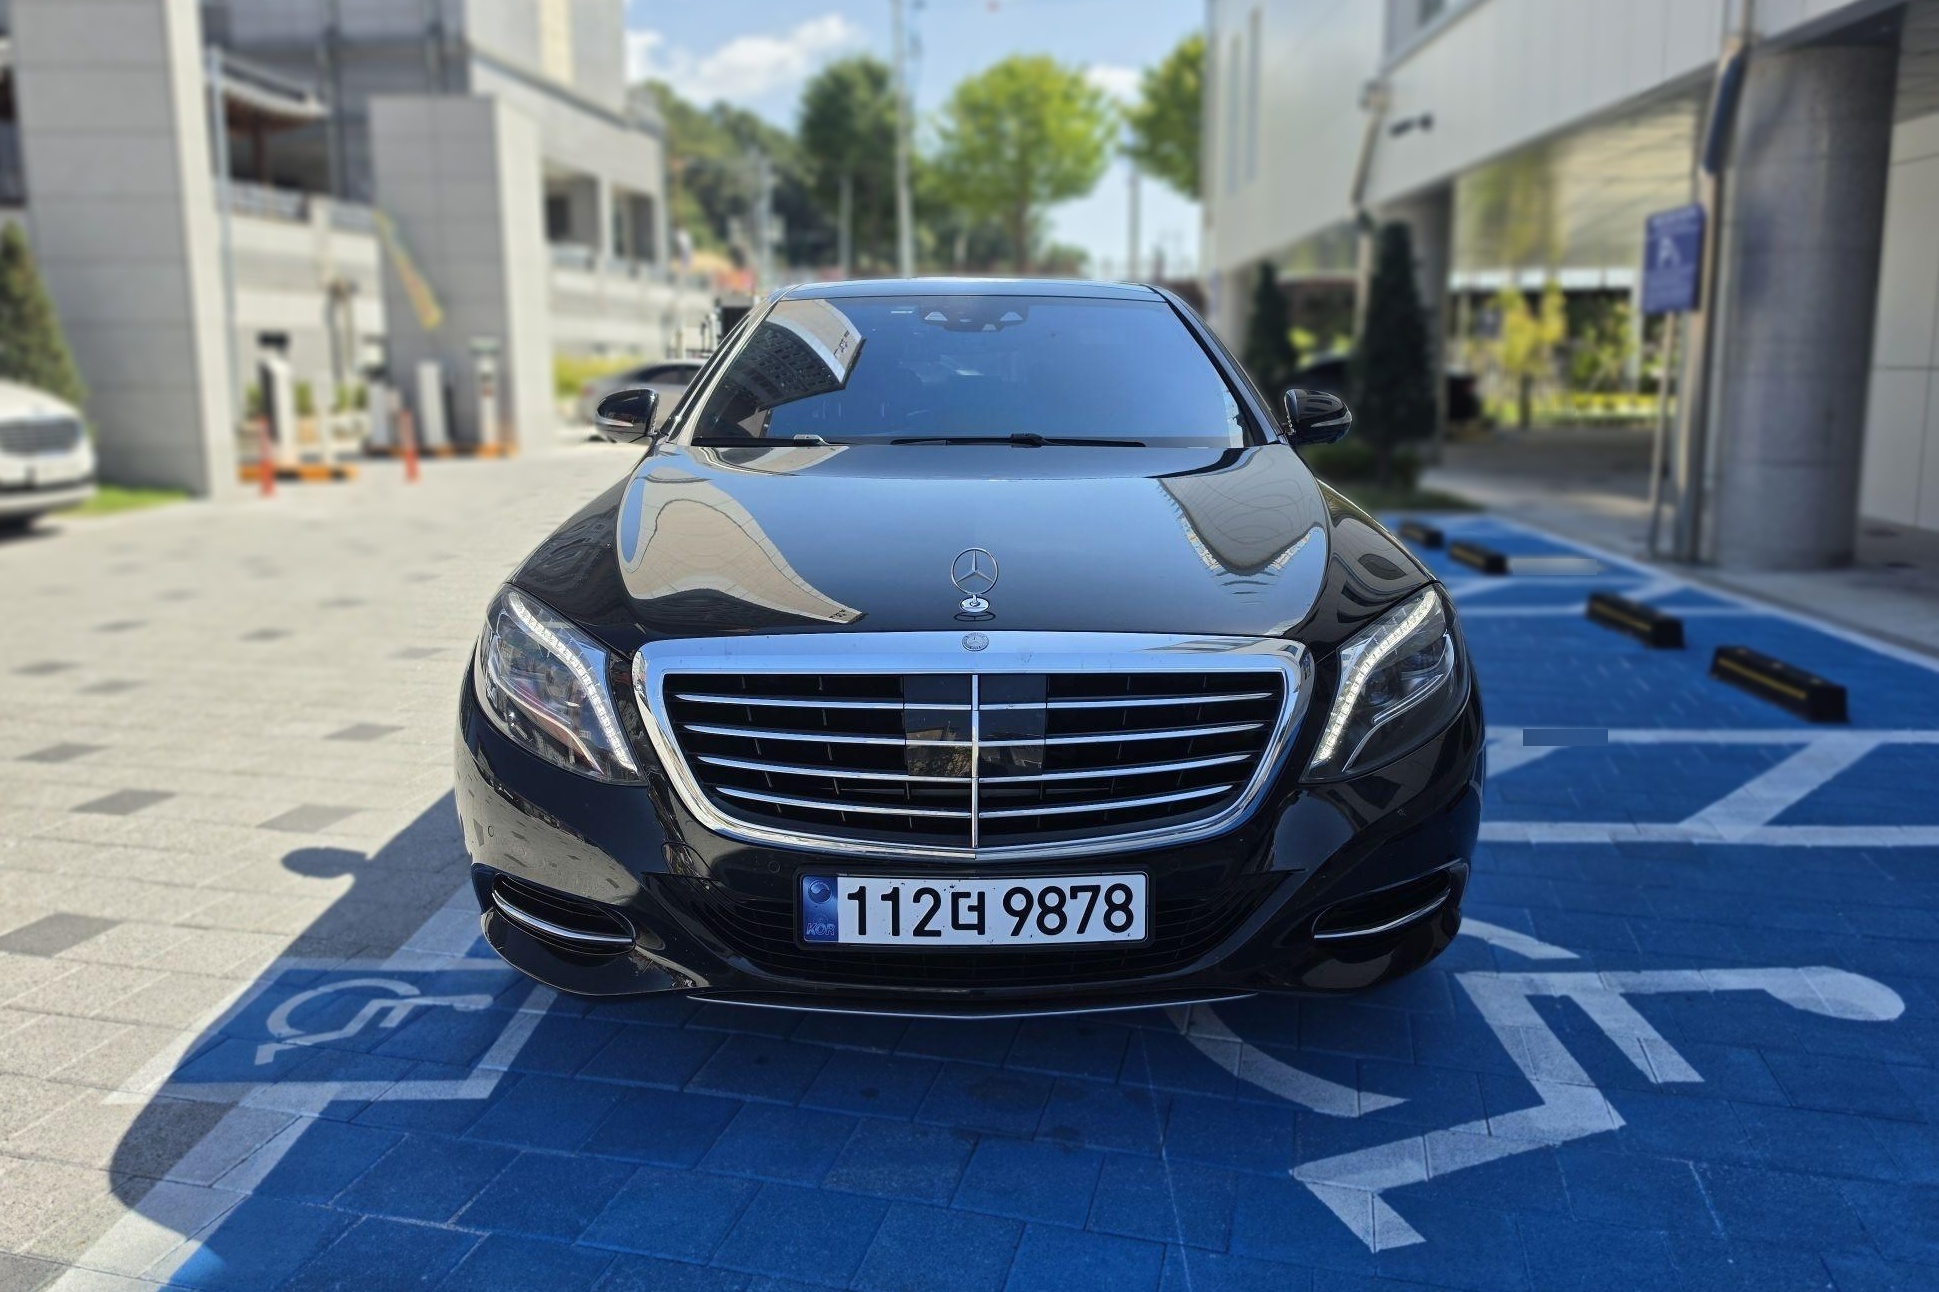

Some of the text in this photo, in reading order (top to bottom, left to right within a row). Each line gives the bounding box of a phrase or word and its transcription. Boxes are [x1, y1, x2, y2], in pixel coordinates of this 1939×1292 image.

[847, 883, 1134, 937] 112더 9878
[806, 922, 835, 936] KOR
